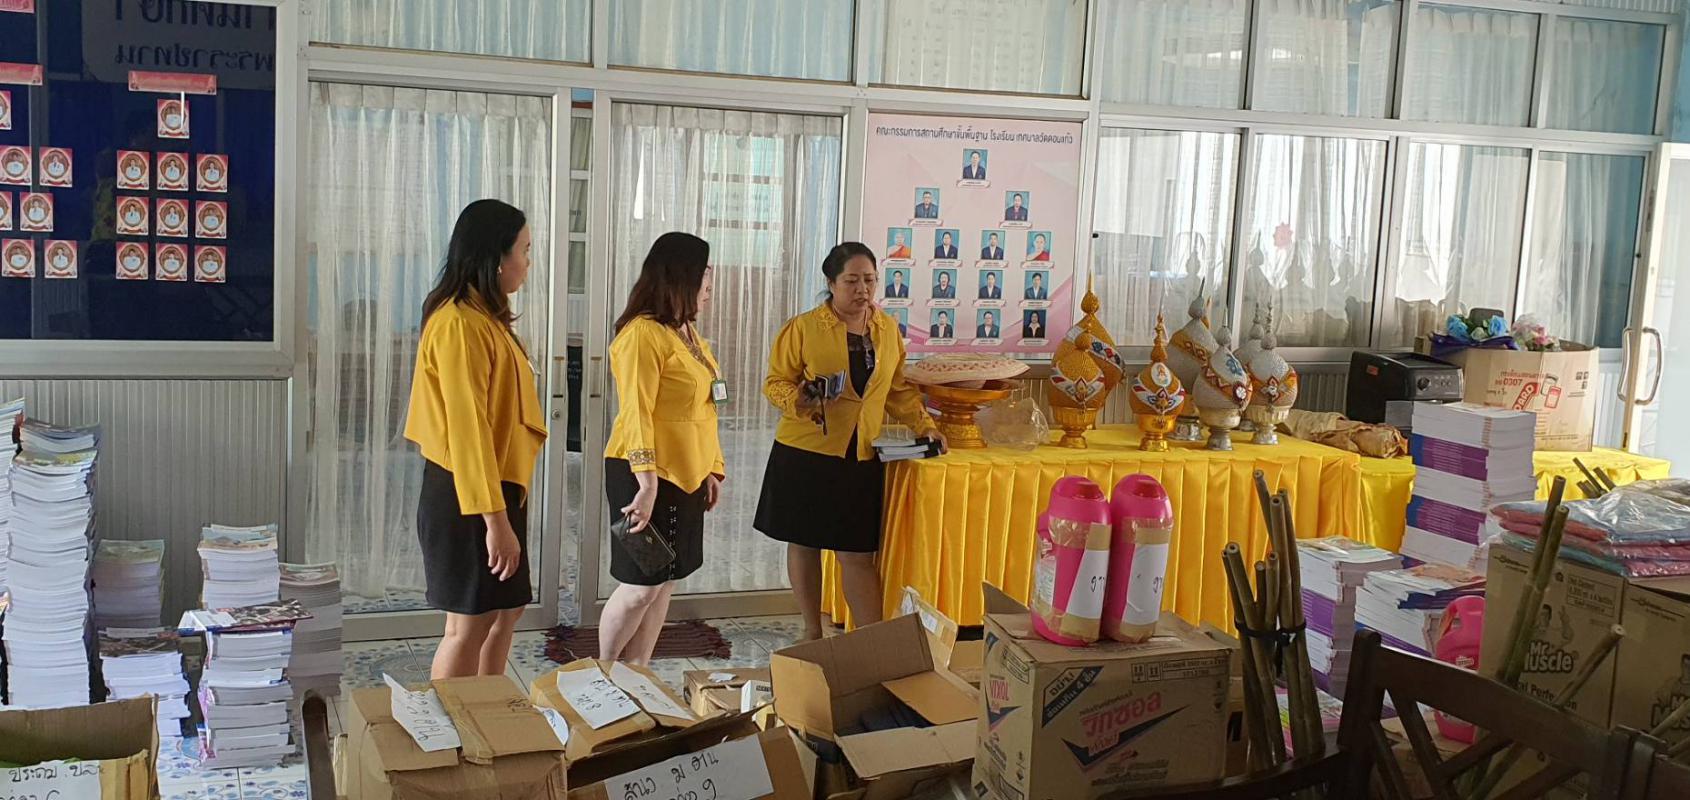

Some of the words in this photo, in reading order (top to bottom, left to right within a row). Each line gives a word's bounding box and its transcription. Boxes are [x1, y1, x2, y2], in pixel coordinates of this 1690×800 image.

[876, 126, 988, 142] คณะกรรมการสถานศึกษาขั้นพื้นฐาน
[990, 130, 1015, 142] โรงเรียน
[1529, 641, 1549, 656] Mr
[990, 680, 1009, 701] VIXOL
